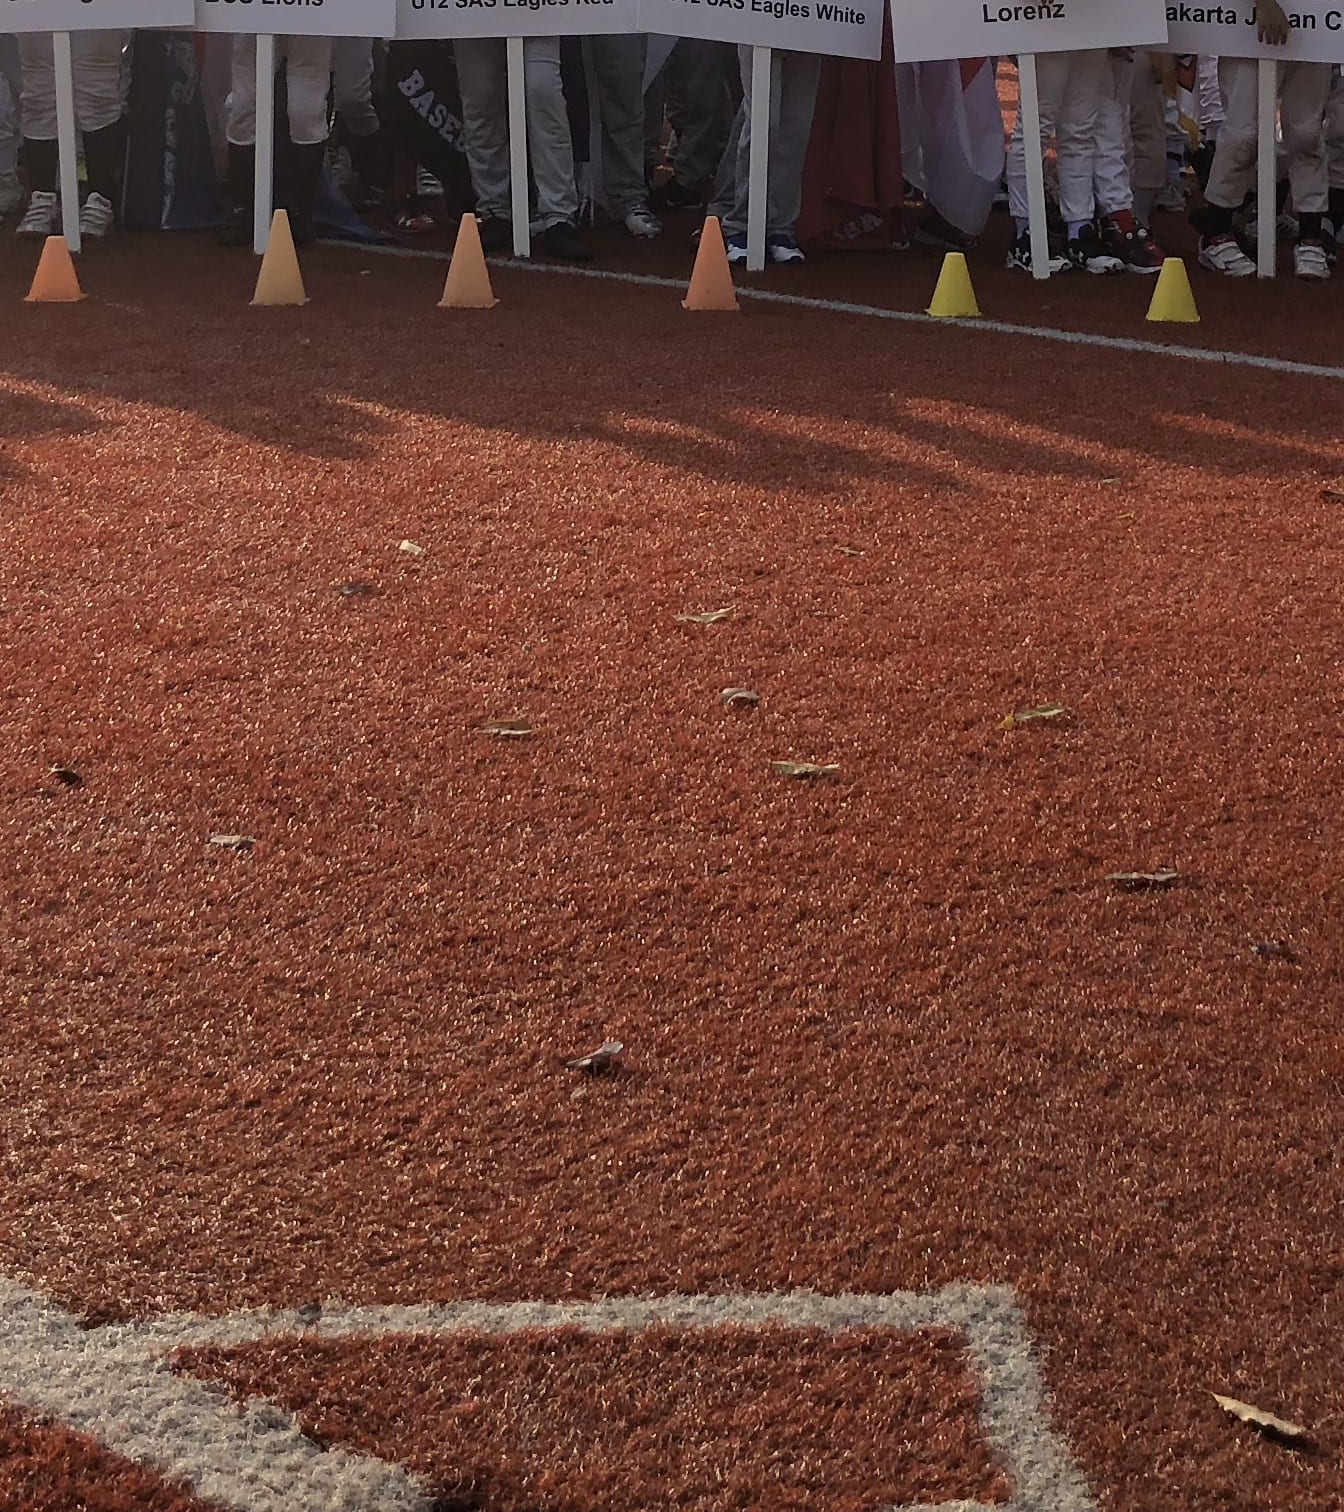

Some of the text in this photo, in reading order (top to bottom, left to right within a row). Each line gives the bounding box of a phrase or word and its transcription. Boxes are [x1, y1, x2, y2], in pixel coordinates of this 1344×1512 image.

[816, 2, 866, 25] White
[982, 1, 1066, 23] Lorenz
[1166, 3, 1238, 25] akarta
[1244, 5, 1317, 29] Jan
